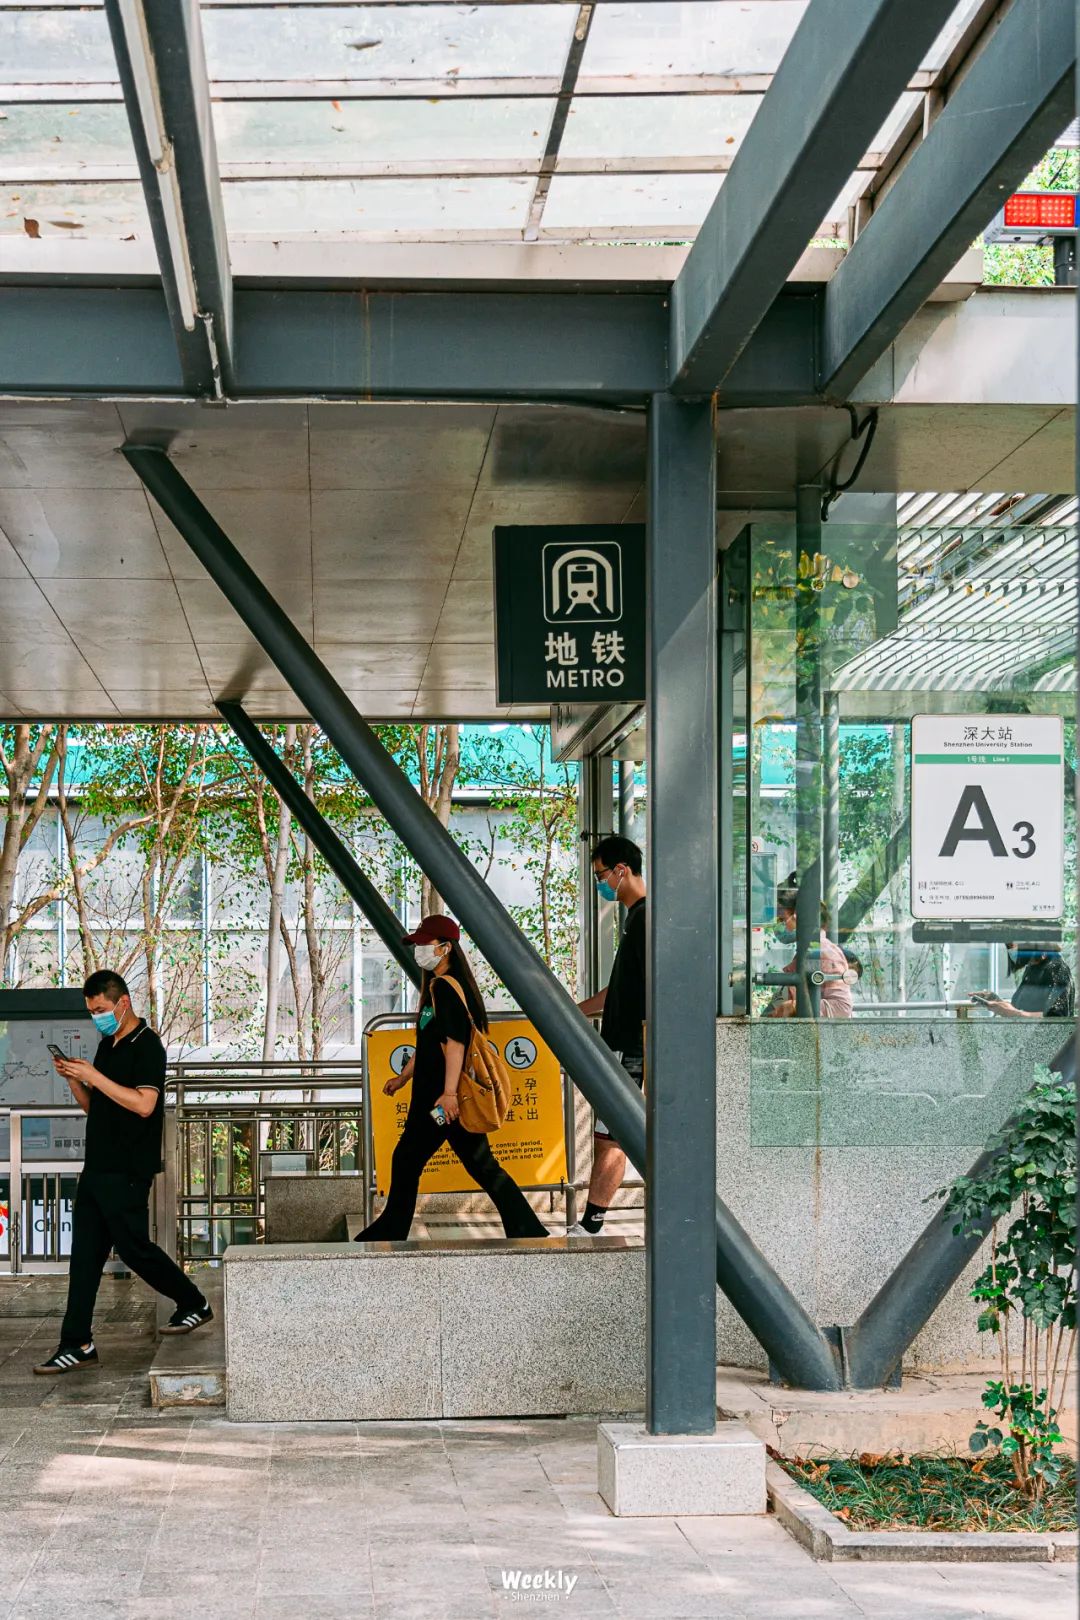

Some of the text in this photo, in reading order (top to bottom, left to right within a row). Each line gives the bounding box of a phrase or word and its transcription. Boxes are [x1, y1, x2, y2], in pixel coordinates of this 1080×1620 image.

[544, 630, 626, 666] 地铁
[546, 668, 625, 688] METRO
[963, 726, 1013, 741] 深大站
[975, 741, 1007, 749] University
